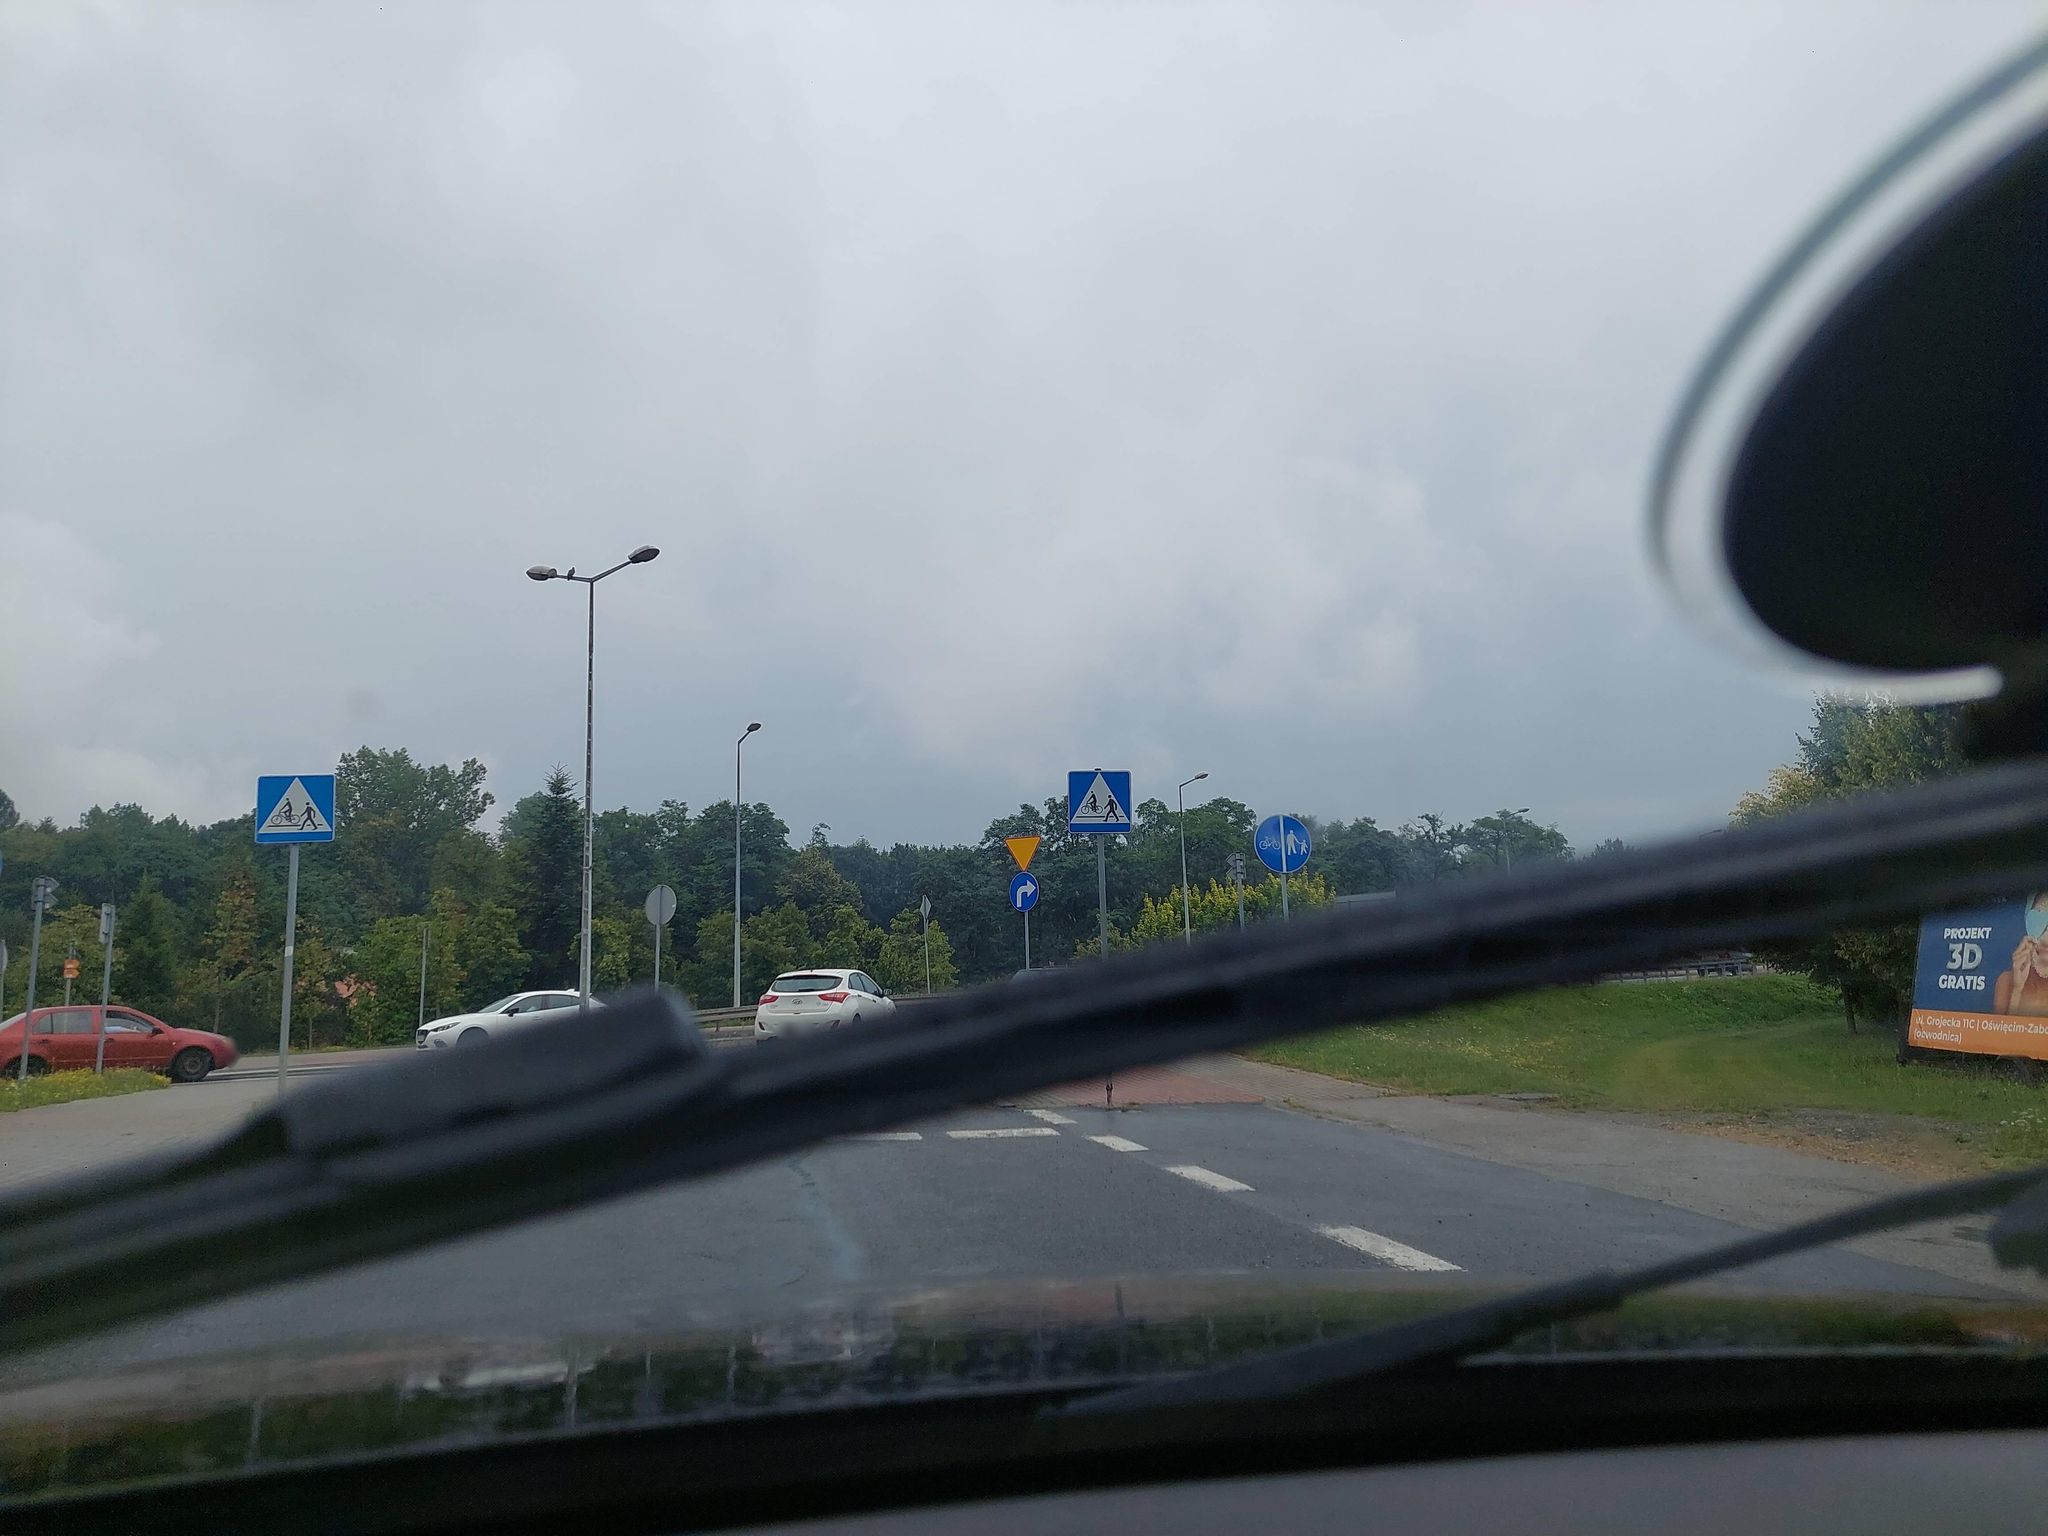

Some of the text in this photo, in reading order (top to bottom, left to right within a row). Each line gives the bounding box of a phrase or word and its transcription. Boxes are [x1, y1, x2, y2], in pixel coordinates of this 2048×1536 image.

[1943, 927, 1992, 939] PROJEKT
[1946, 943, 1983, 970] 3D
[1938, 975, 1986, 991] GRATIS
[1926, 1016, 1961, 1028] Grojecka
[1963, 1018, 1975, 1029] 11C
[1914, 1028, 1962, 1044] (obwodnica)
